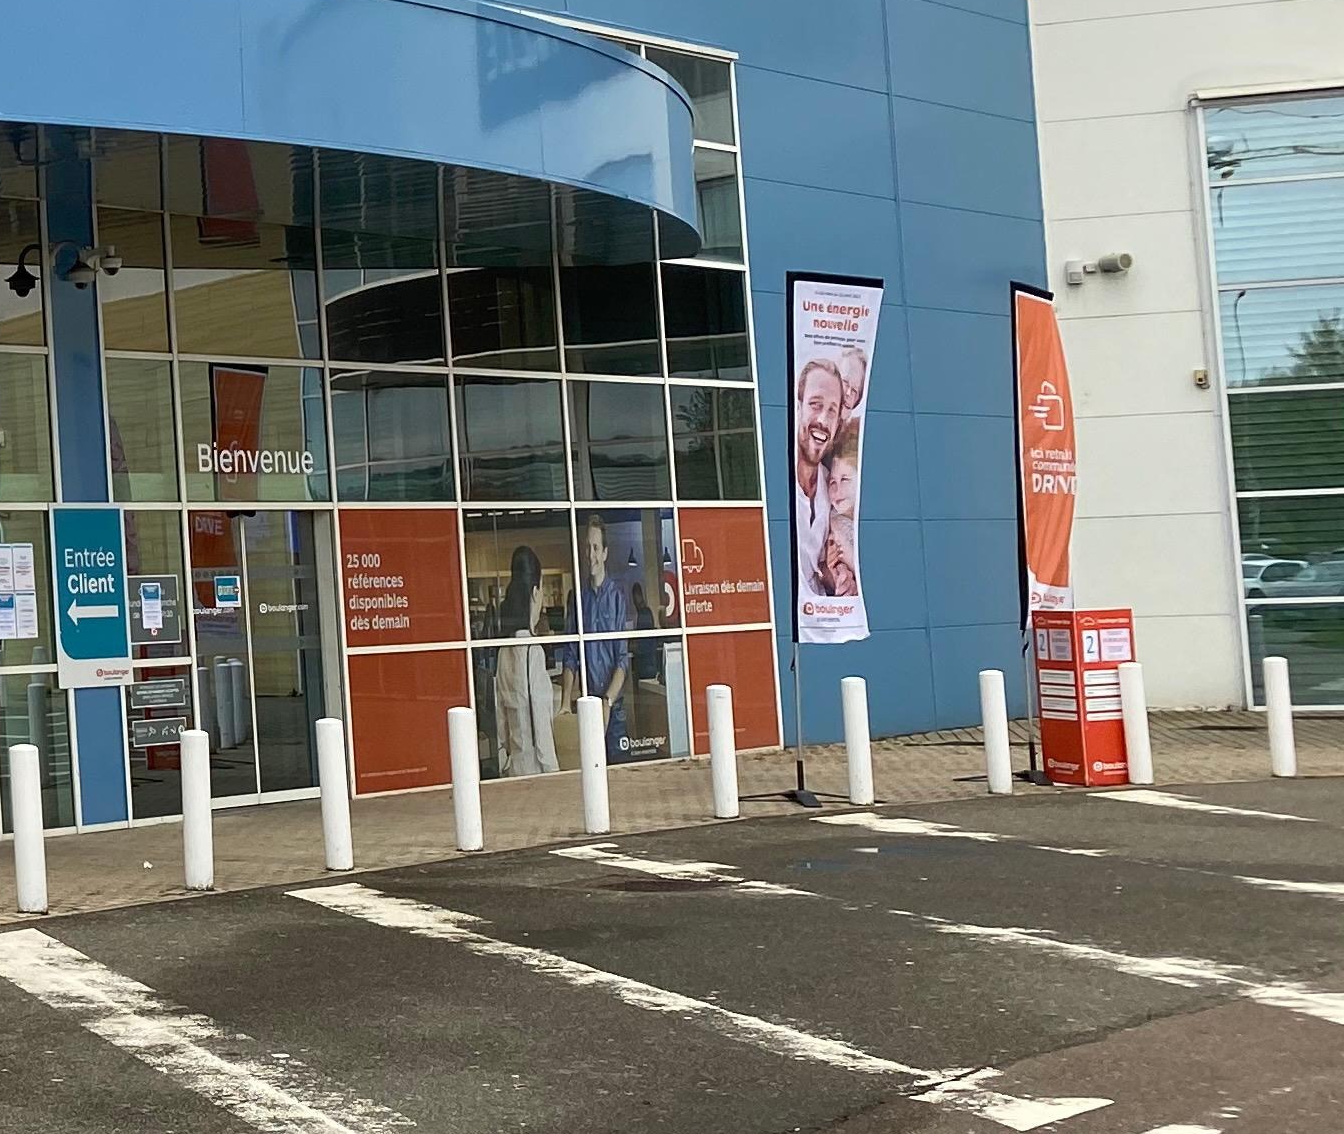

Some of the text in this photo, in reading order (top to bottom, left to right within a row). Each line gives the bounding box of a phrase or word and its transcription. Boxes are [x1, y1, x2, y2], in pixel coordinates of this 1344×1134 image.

[803, 300, 824, 313] Une
[197, 442, 314, 474] Bienvenue
[64, 546, 115, 568] Entrée
[346, 554, 380, 568] 25 000
[68, 573, 115, 594] Client
[348, 573, 404, 588] références
[684, 581, 720, 595] Livraison
[721, 580, 735, 593] dès
[349, 593, 409, 612] disponibles
[685, 599, 713, 613] offerte
[351, 614, 410, 631] dès demain
[1085, 635, 1095, 654] 2
